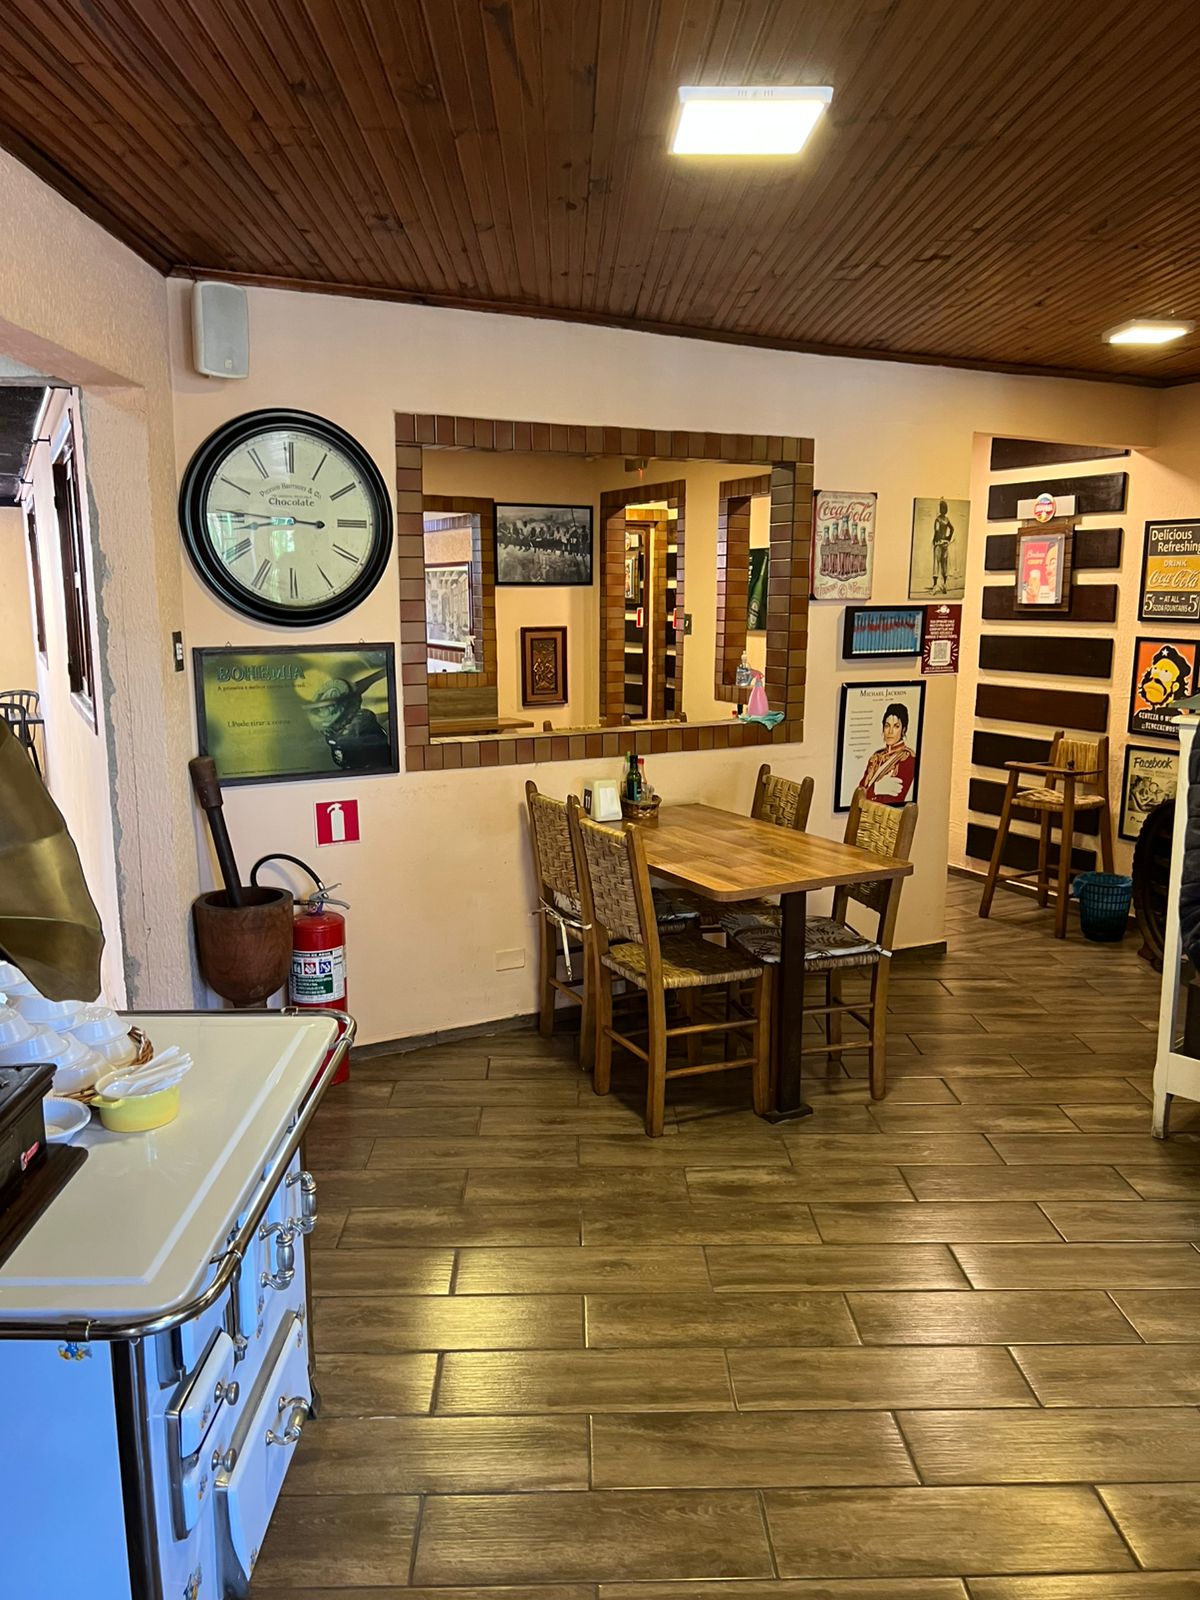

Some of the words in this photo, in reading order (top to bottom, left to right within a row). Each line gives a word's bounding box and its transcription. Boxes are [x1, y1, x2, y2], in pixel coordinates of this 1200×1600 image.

[268, 497, 315, 507] Chocolate
[1151, 528, 1193, 541] Delicious
[1171, 595, 1180, 603] ALL
[216, 663, 306, 683] BOHEMIA
[1133, 757, 1173, 770] Facebook
